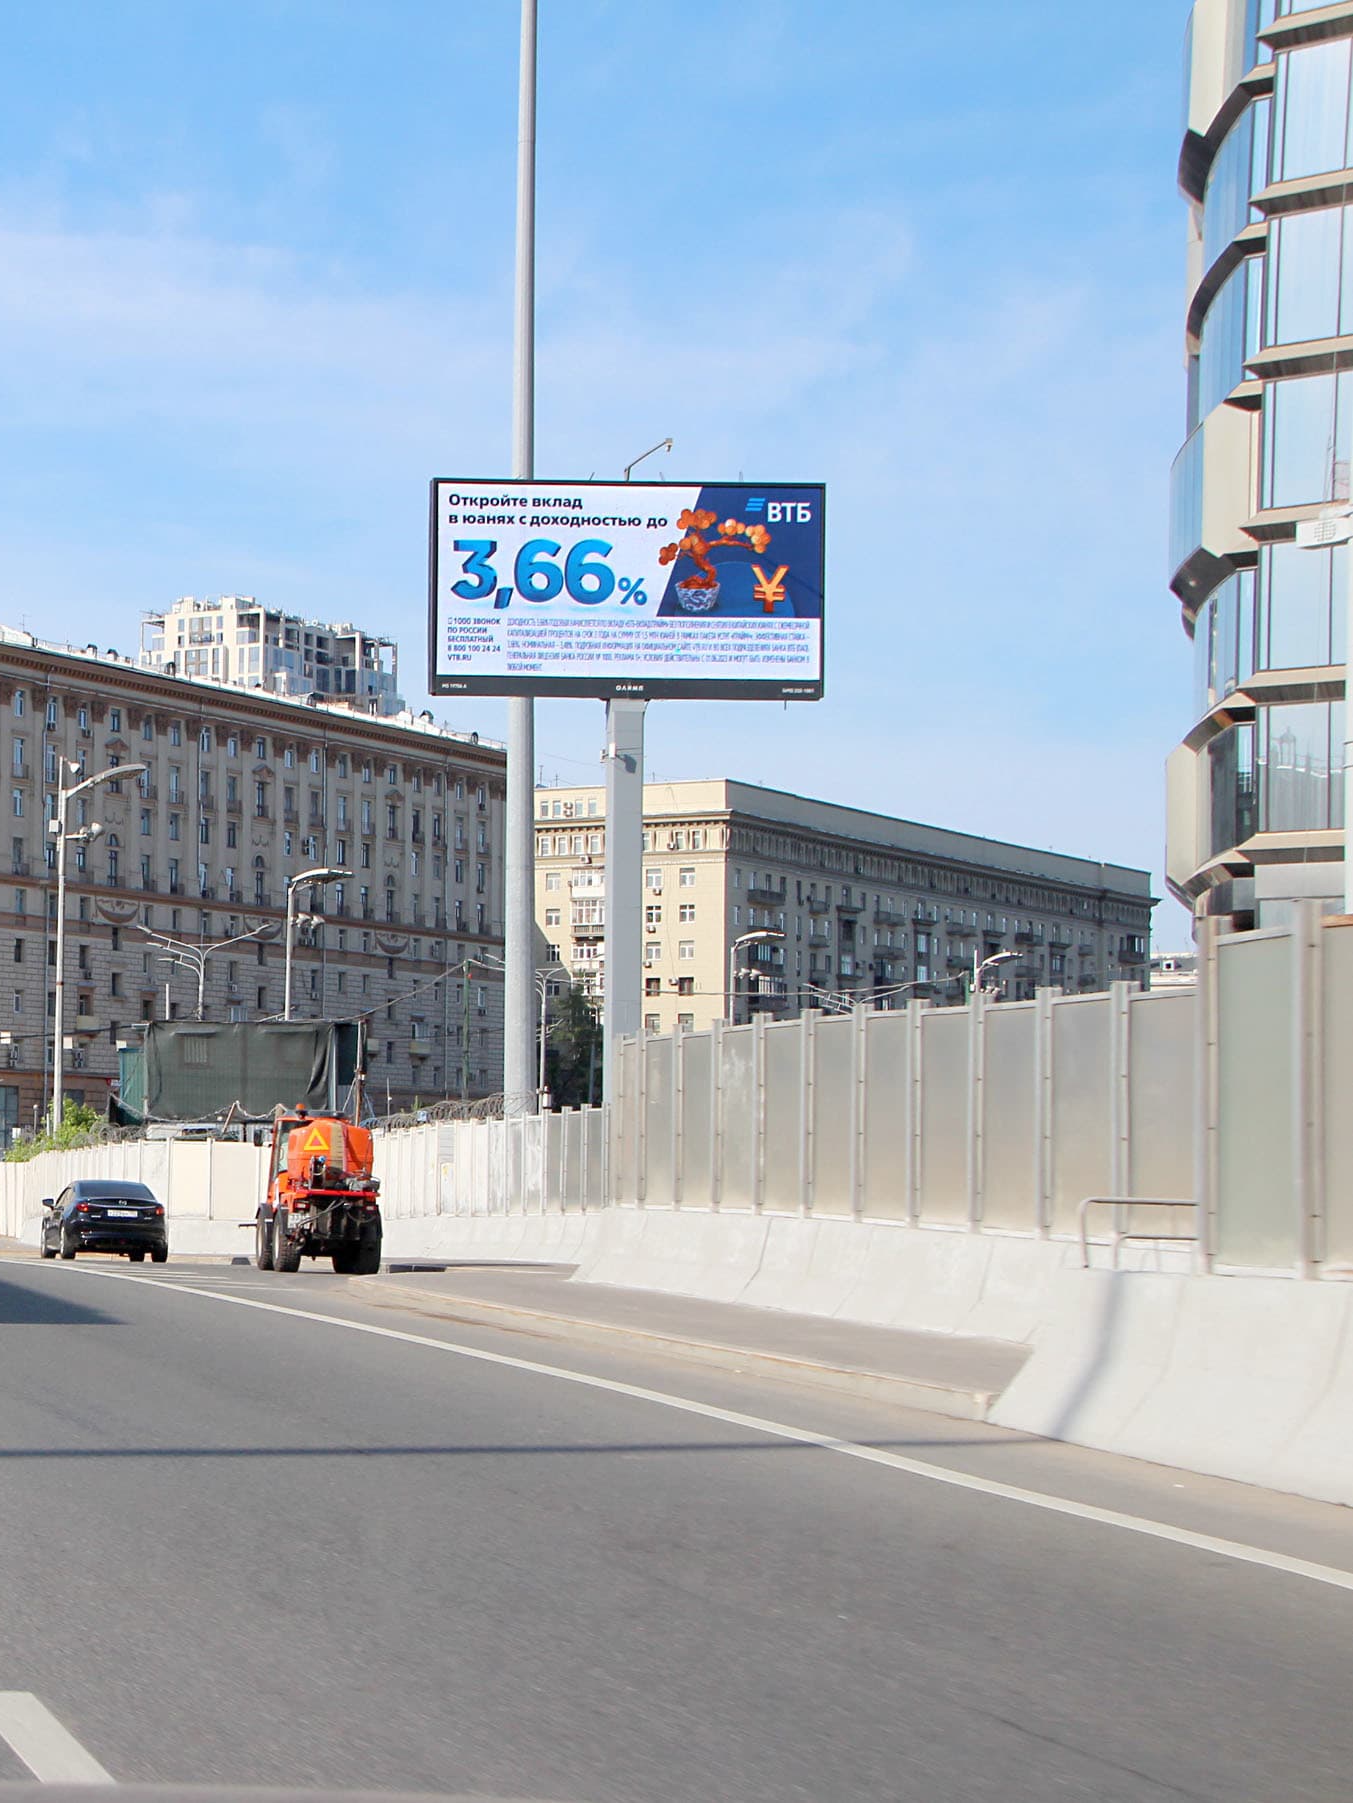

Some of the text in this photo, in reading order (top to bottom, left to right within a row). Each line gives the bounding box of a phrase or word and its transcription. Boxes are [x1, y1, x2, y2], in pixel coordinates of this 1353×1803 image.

[448, 494, 583, 509] Откройте вклад
[767, 502, 812, 523] ВТБ
[448, 514, 668, 529] в юанях с доходностью до
[450, 538, 648, 609] 3,66%
[448, 626, 488, 634] ПО РОССИИ
[448, 635, 494, 643] БЕСПЛАТНЫЙ
